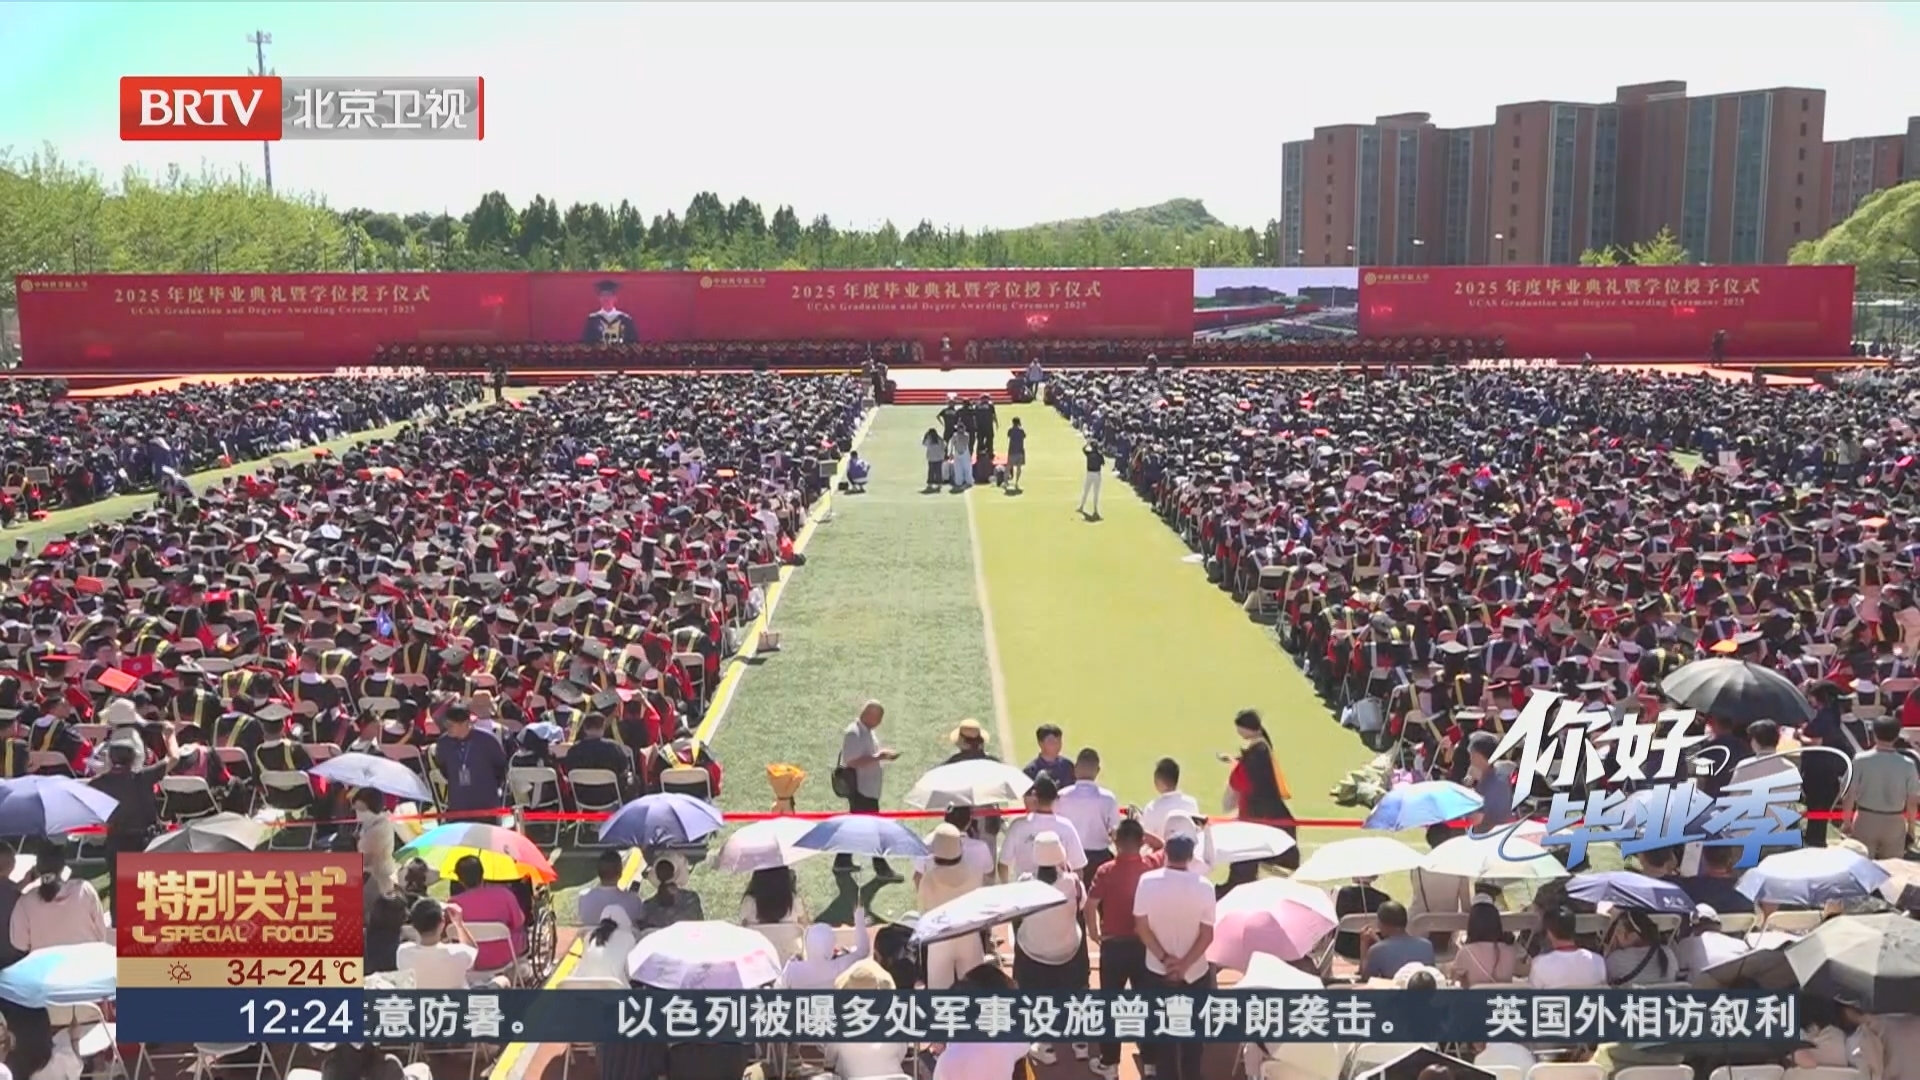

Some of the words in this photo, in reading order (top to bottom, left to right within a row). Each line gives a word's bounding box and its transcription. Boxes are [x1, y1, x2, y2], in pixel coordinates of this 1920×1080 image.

[114, 289, 160, 303] 2025
[167, 284, 431, 303] 年度毕业典礼暨学位授予仪式
[791, 284, 836, 299] 2025
[844, 280, 1101, 299] 年度毕业典礼暨学位授予仪式
[1455, 281, 1497, 295] 2025
[1505, 278, 1760, 296] 年度毕业典礼暨学位授予仪式
[226, 306, 244, 314] and
[901, 302, 918, 310] and
